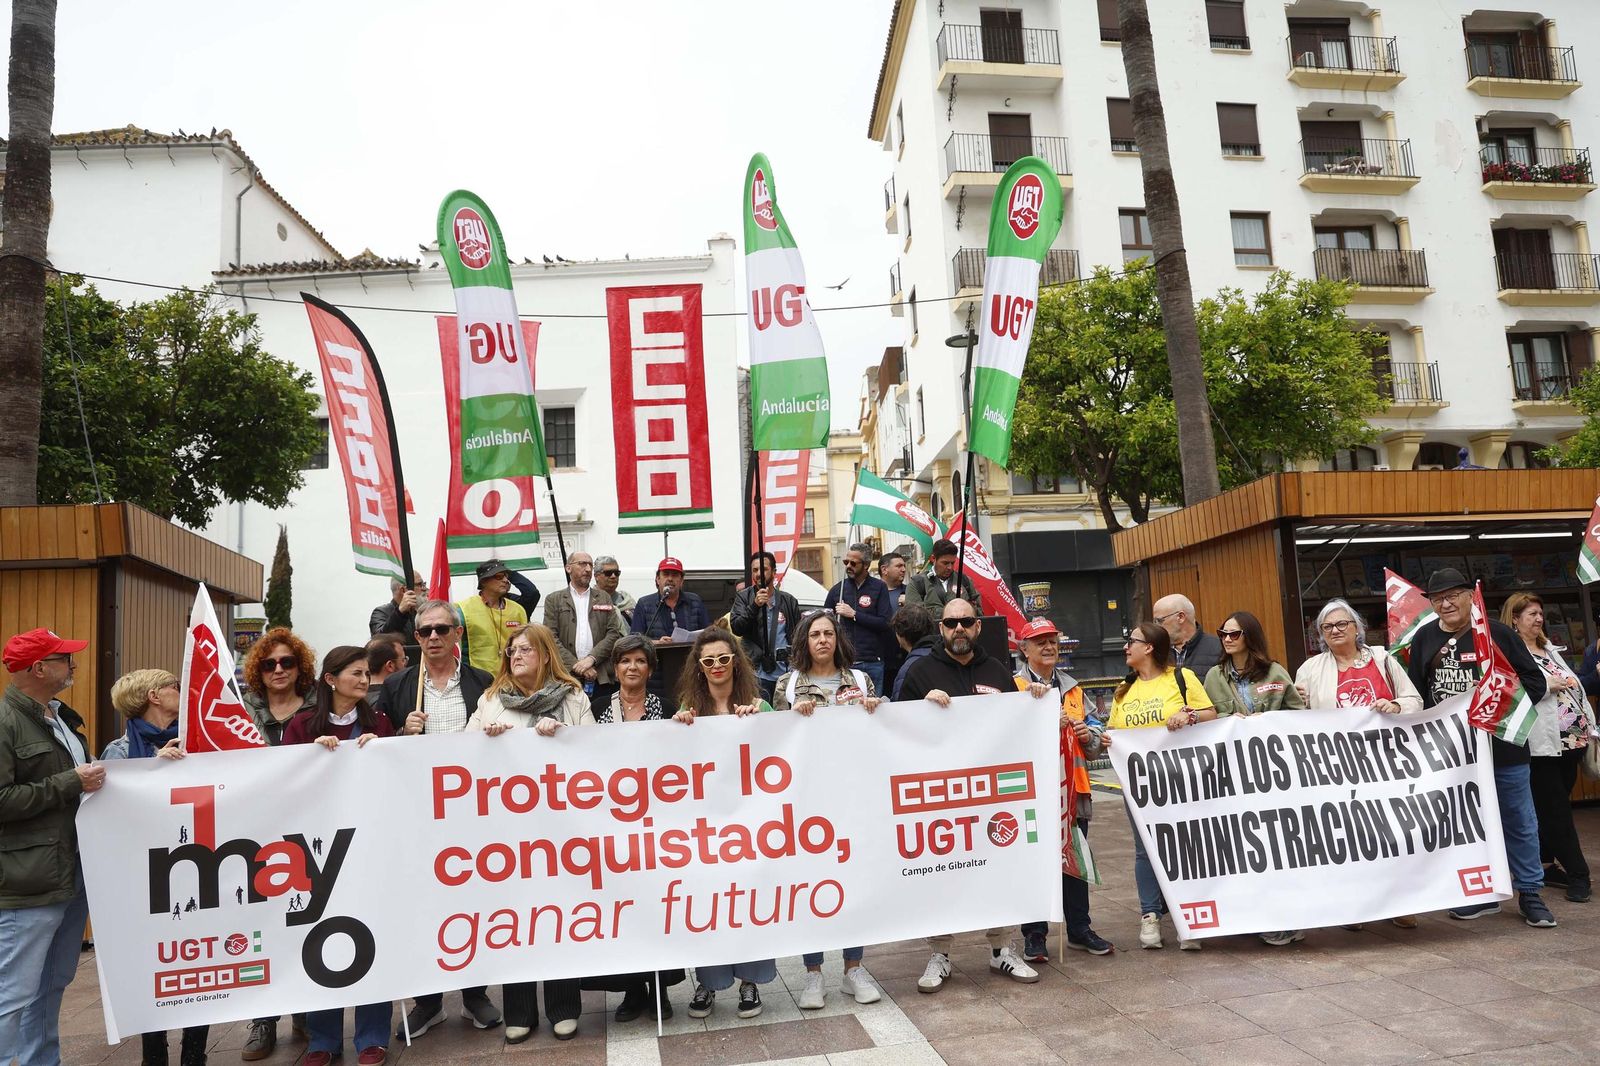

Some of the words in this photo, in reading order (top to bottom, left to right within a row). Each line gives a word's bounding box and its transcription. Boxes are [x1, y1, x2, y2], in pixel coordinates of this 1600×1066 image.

[1013, 185, 1040, 211] UGT
[752, 283, 805, 331] UG
[628, 295, 692, 510] CCOO
[761, 395, 830, 417] Andalucía
[543, 540, 572, 549] PLAA
[1435, 668, 1473, 684] GUZMAN
[1126, 709, 1165, 727] POSTAL
[1127, 741, 1236, 808] CONTRA
[1233, 733, 1292, 794] LOS
[1287, 726, 1422, 788] RECORTES
[1411, 718, 1461, 773] EN
[431, 760, 715, 823] Proteger
[739, 743, 792, 796] lo
[898, 774, 992, 807] CCOO
[433, 804, 850, 890] conquistado,
[896, 815, 979, 860] UGT
[1146, 789, 1399, 882] DMINISTRACIÓN
[902, 866, 933, 877] Campo
[935, 863, 946, 872] de
[948, 858, 988, 871] Gibraltar
[437, 899, 633, 972] ganar
[662, 878, 845, 935] futuro
[157, 936, 219, 963] UGT
[160, 968, 235, 993] CCOO
[156, 998, 183, 1008] Campo
[184, 995, 194, 1003] de
[196, 991, 230, 1002] Gibraltar
